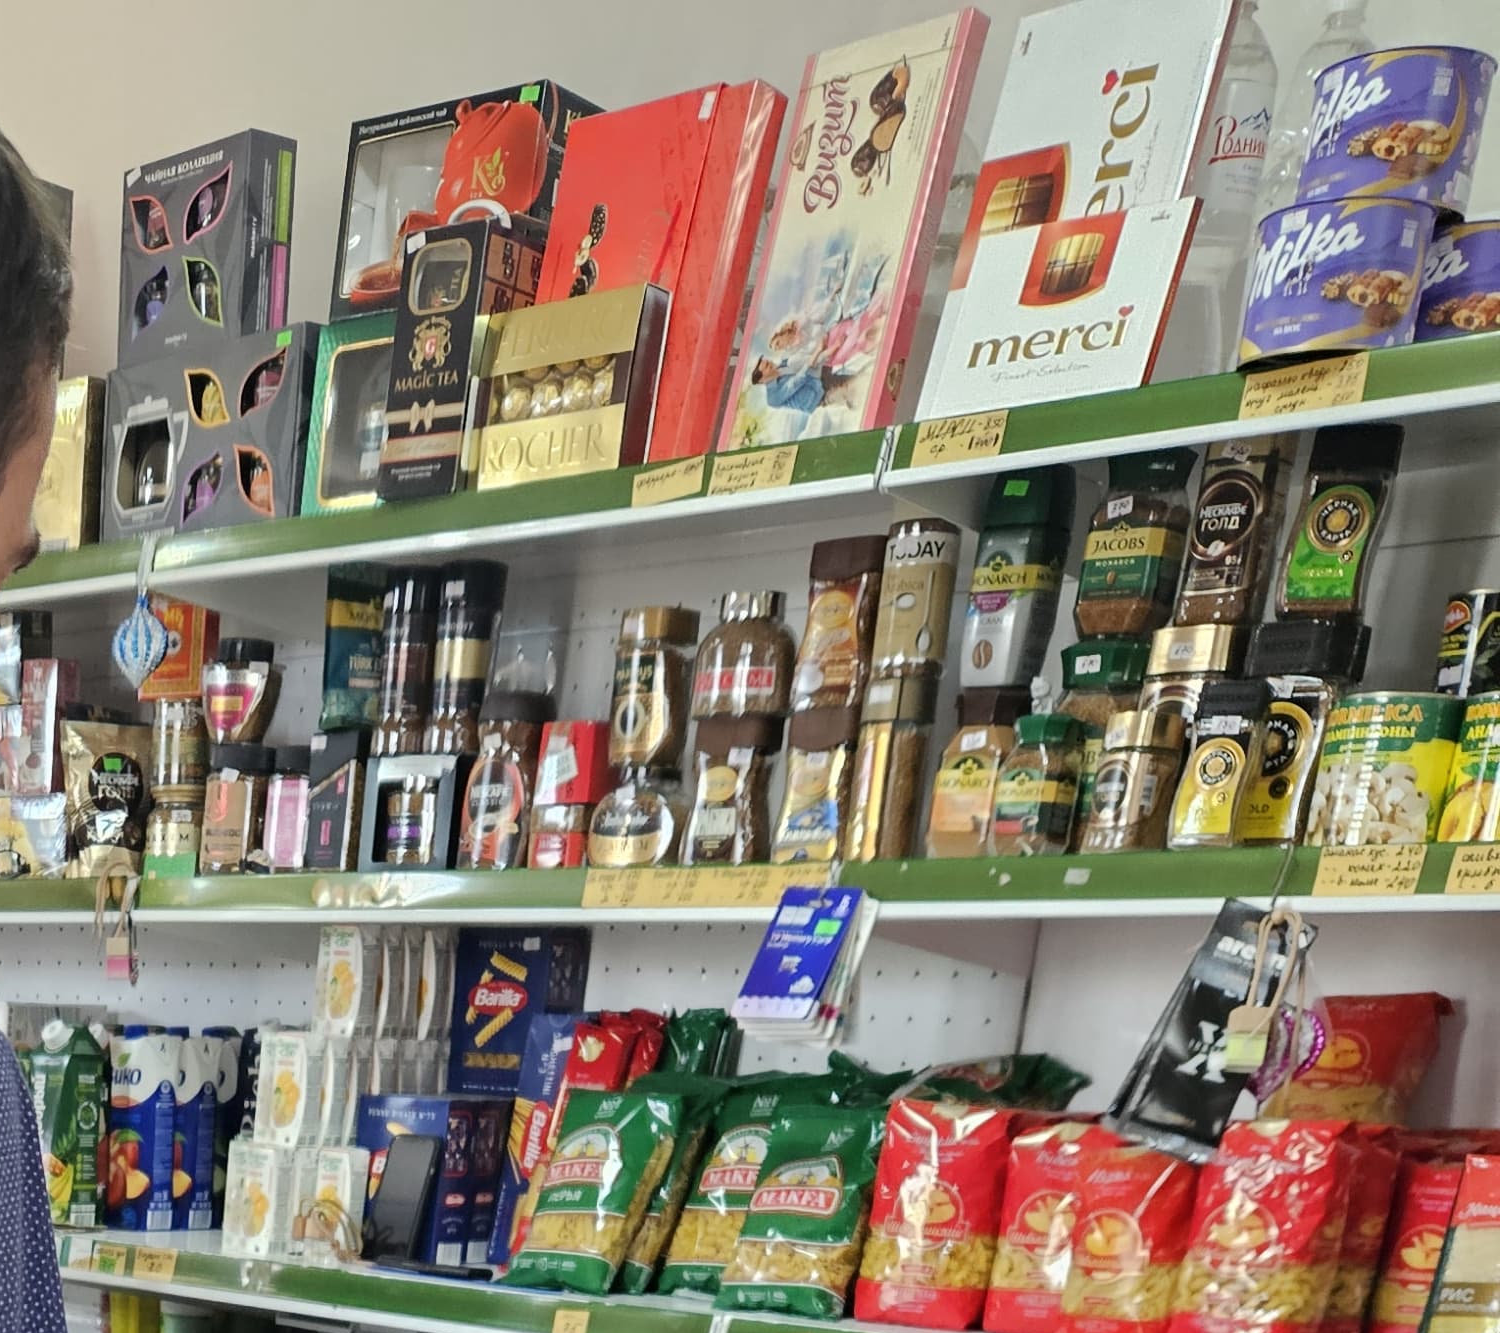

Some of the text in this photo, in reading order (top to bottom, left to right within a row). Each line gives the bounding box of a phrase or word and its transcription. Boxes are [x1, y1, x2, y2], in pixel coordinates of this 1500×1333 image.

[804, 74, 860, 214] Визит
[1085, 64, 1159, 217] erci
[1249, 213, 1365, 307] Milka
[967, 305, 1135, 370] merci
[436, 370, 459, 388] TEA
[1036, 362, 1091, 379] Selection
[482, 422, 606, 474] ROCHER
[1200, 502, 1248, 519] НЕСКАФЕ
[1201, 514, 1241, 532] ГОЛД
[888, 541, 946, 562] TDAY
[1092, 536, 1146, 554] JACOBS
[1095, 557, 1136, 567] MONARCH
[474, 988, 525, 1008] Barilla
[524, 1110, 547, 1170] Barilla
[759, 1190, 829, 1209] MAKFA
[1439, 1287, 1477, 1303] РИС
